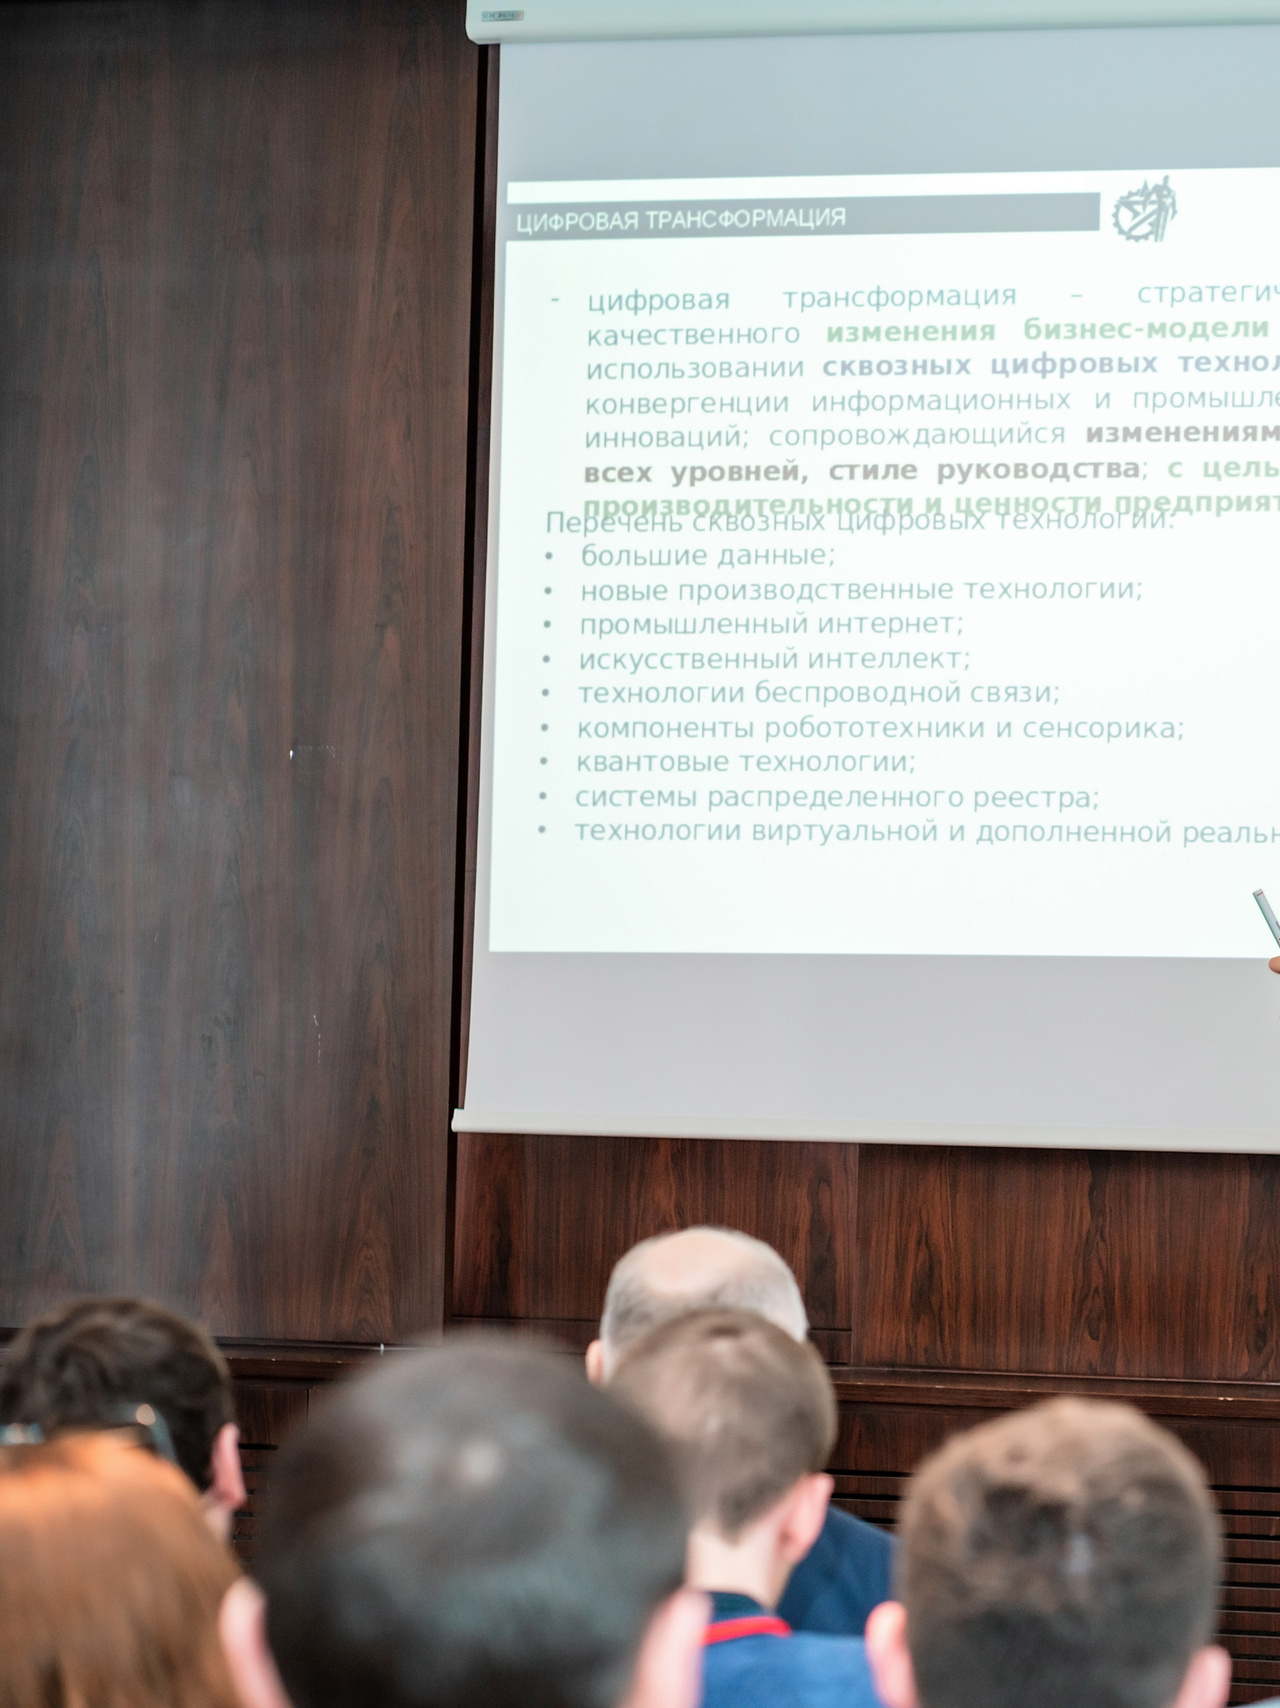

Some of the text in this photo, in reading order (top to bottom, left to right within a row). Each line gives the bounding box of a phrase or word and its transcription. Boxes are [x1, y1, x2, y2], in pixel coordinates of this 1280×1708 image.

[517, 207, 847, 236] ЦИФРОВАЯ ТРАНСФОРМАЦИЯ
[588, 286, 731, 318] цифровая
[782, 283, 1017, 315] трансформация
[587, 325, 801, 348] качественного
[826, 322, 996, 345] изменения
[1023, 315, 1270, 344] бизнес-модели
[586, 358, 805, 382] использовании
[822, 356, 972, 379] сквозных
[990, 348, 1159, 381] цифровых
[586, 394, 790, 421] конвергенции
[812, 387, 1072, 418] информационных
[1095, 390, 1111, 411] и
[585, 422, 749, 453] инноваций;
[768, 419, 1066, 453] сопровождающийся
[583, 464, 653, 485] всех
[670, 456, 809, 489] уровней,
[828, 461, 919, 482] стиле
[937, 460, 1148, 487] руководства;
[1167, 459, 1184, 480] с
[546, 509, 683, 539] Перечень
[692, 511, 826, 533] сквозных
[837, 507, 985, 536] цифровых
[583, 497, 913, 519] производительности
[925, 496, 943, 516] и
[955, 495, 1102, 518] ценности
[581, 541, 835, 571] большие данные;
[581, 580, 1143, 608] новые производственные технологии;
[580, 609, 964, 642] промышленный интернет;
[579, 644, 970, 677] искусственный интеллект;
[577, 677, 1060, 710] технологии беспроводной связи;
[577, 712, 1184, 746] компоненты робототехники и сенсорика;
[577, 753, 916, 776] квантовые технологии;
[575, 788, 1099, 815] системы распределенного реестра;
[573, 821, 742, 843] технологии
[752, 816, 938, 848] виртуальной
[949, 822, 966, 843] и
[975, 817, 1172, 847] дополненной
